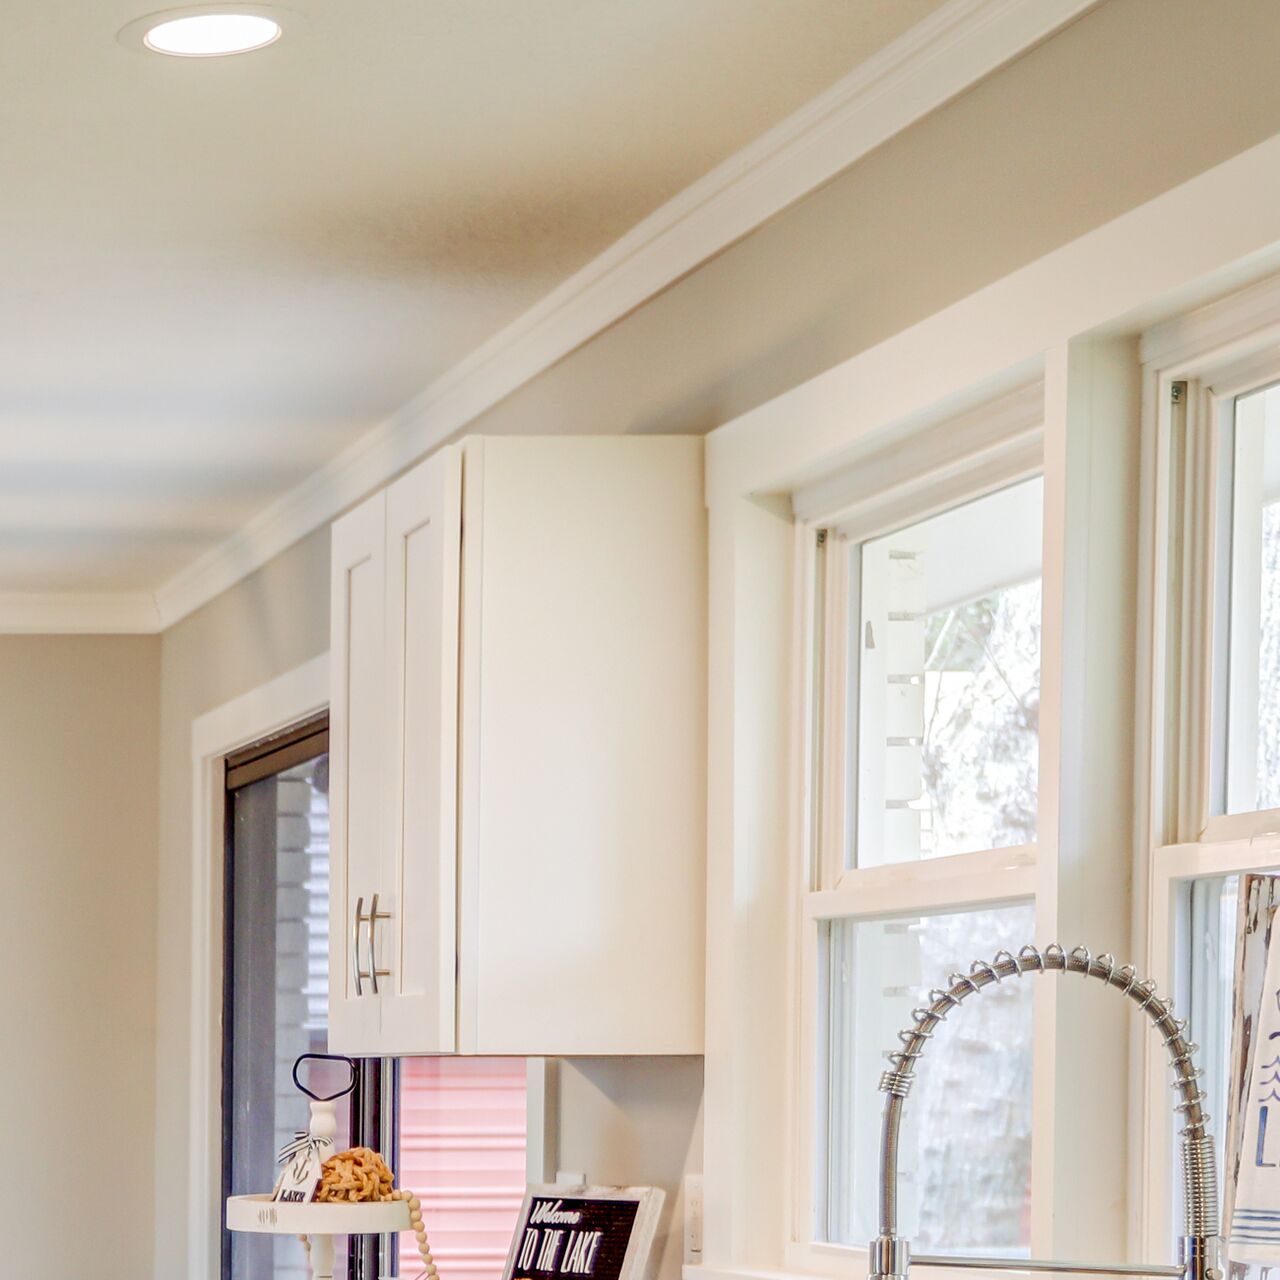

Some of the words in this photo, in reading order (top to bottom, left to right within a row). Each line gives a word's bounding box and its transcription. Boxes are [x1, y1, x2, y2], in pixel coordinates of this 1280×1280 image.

[529, 1199, 580, 1225] Welcome
[517, 1228, 539, 1271] TO
[535, 1228, 565, 1272] THE
[560, 1230, 603, 1274] LAKE
